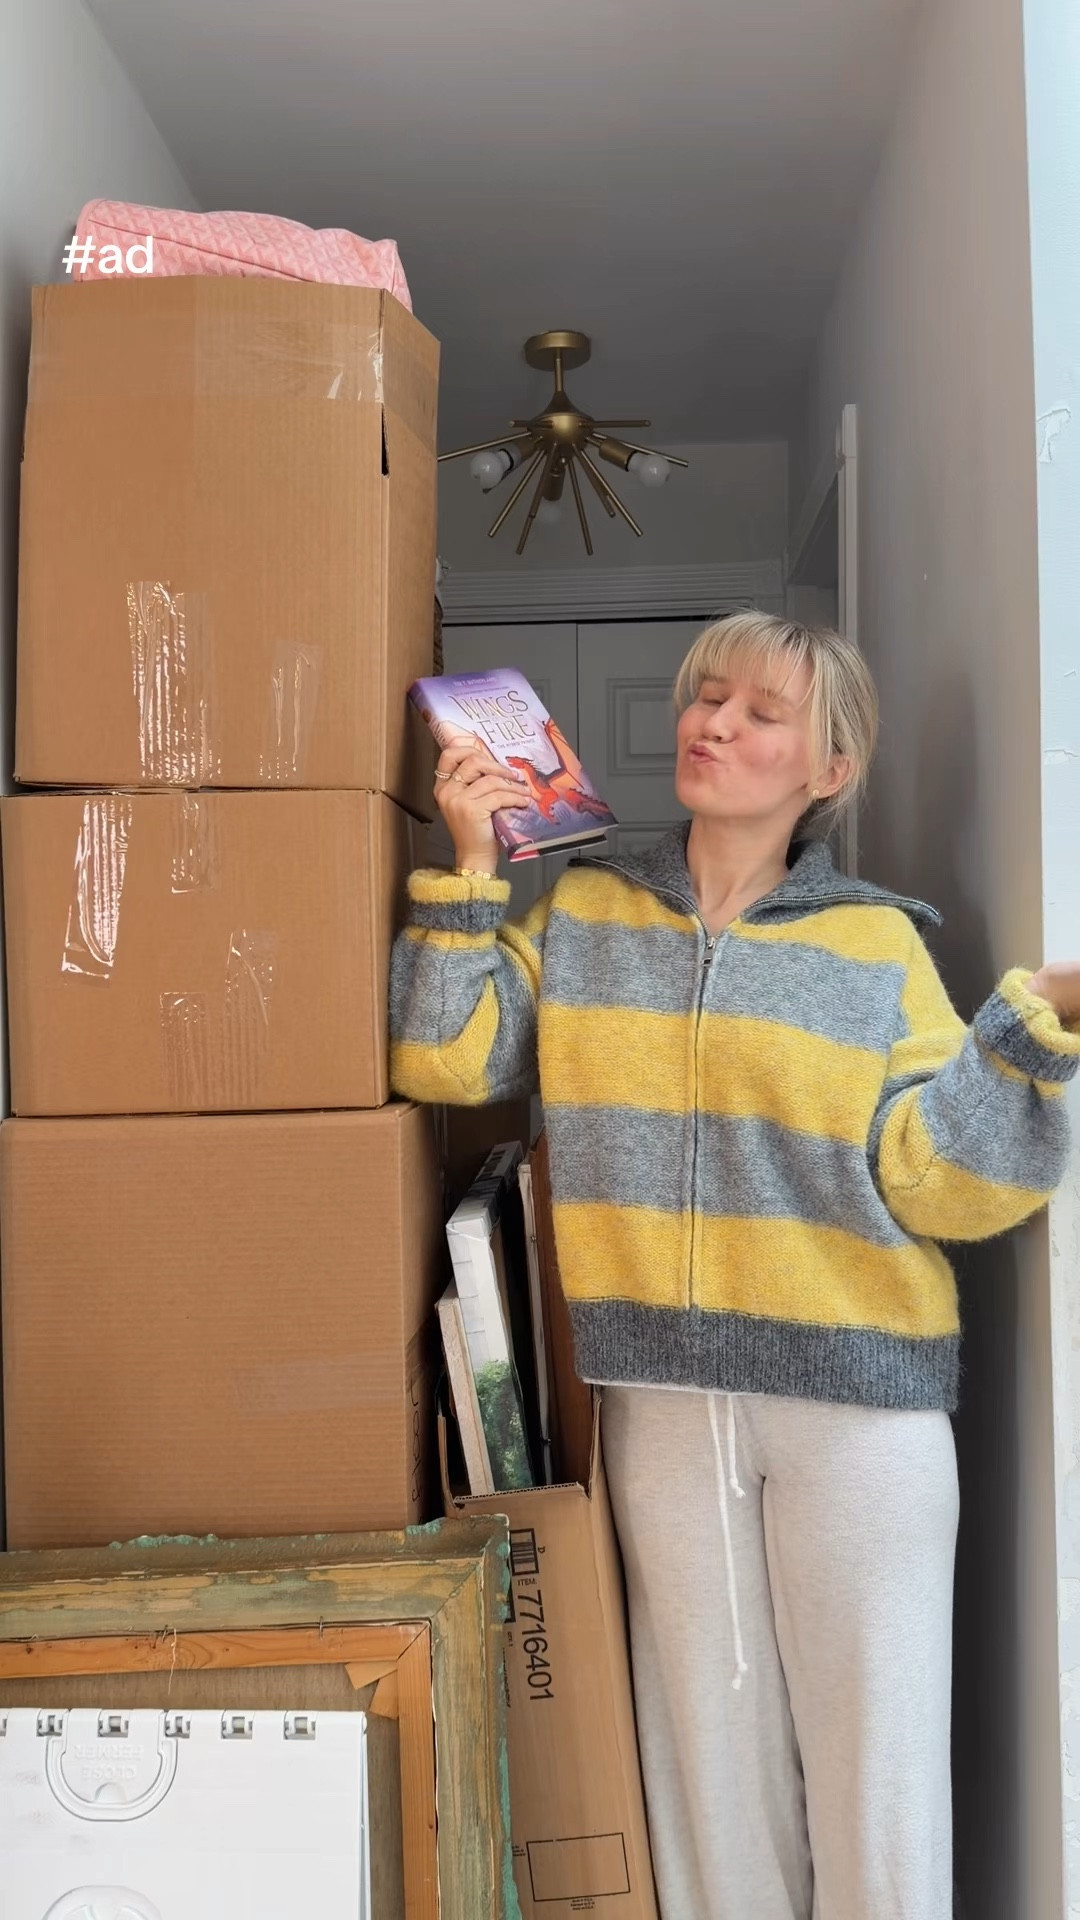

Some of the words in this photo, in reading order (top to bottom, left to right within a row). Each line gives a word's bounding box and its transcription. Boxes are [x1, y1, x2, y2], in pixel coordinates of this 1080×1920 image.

[448, 690, 528, 720] WINGS
[477, 714, 536, 744] FIRE
[517, 1589, 554, 1700] 7716401
[81, 1764, 136, 1781] CLOSE
